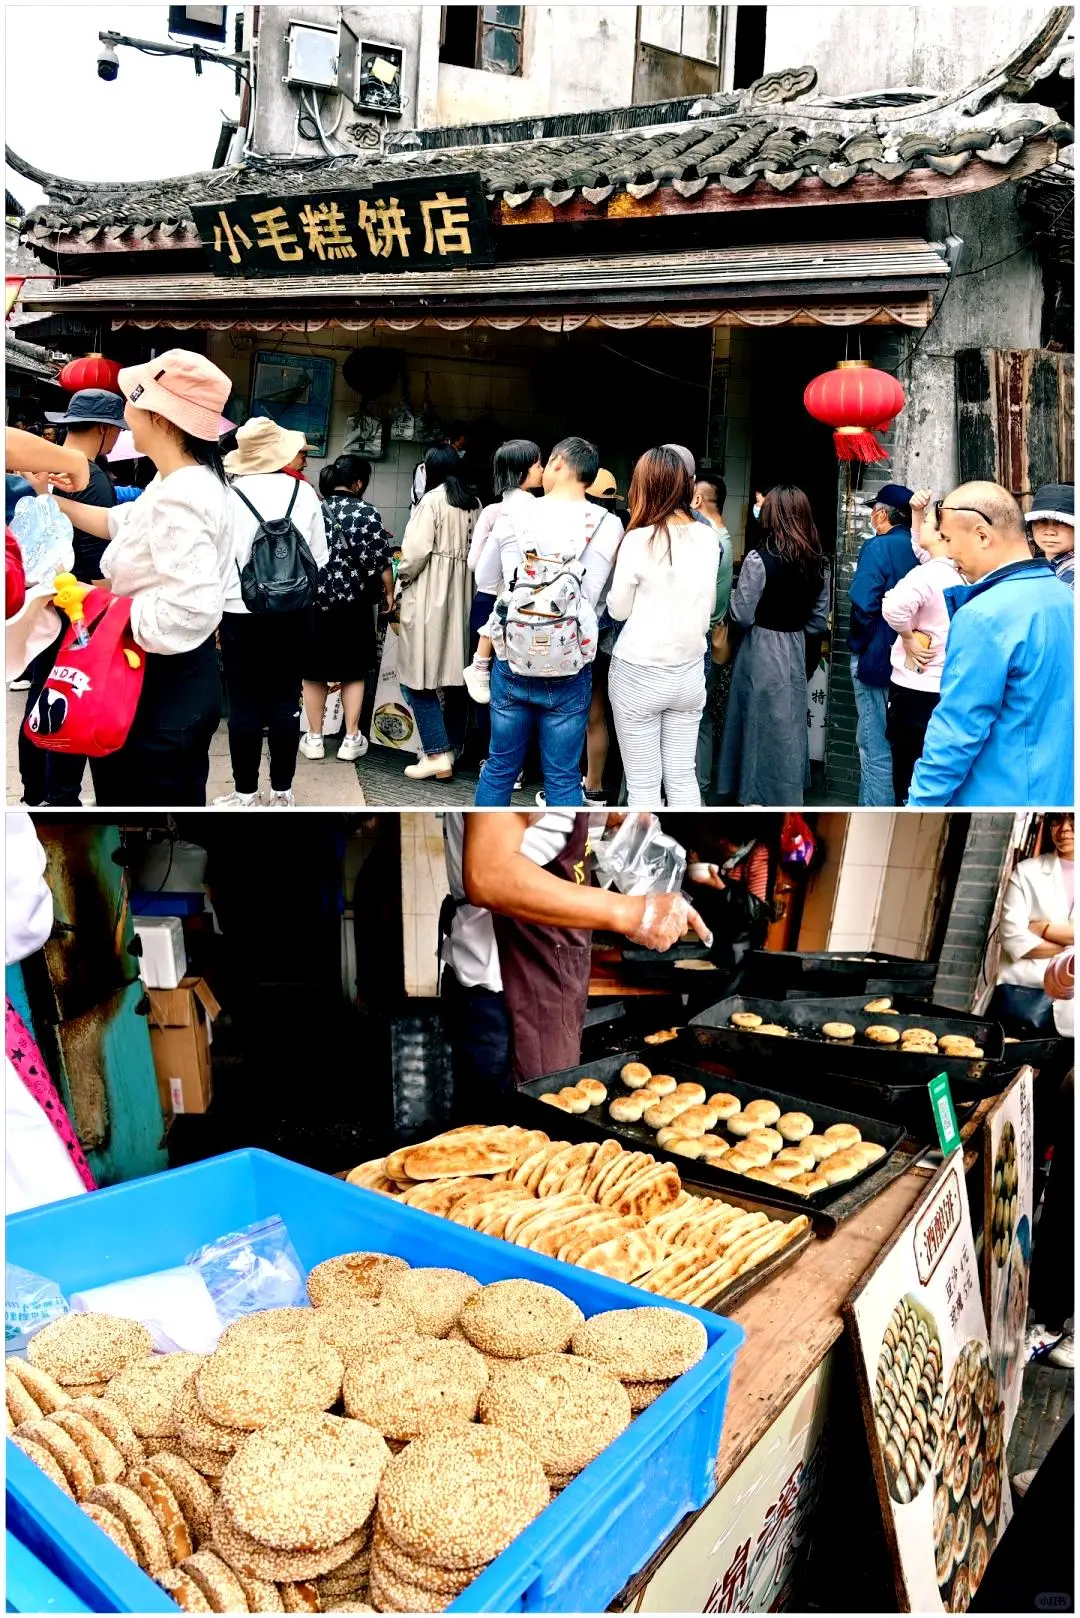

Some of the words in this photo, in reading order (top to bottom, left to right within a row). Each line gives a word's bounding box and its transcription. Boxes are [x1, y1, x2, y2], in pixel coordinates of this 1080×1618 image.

[213, 191, 472, 264] 小毛糕饼店
[811, 688, 827, 705] 特
